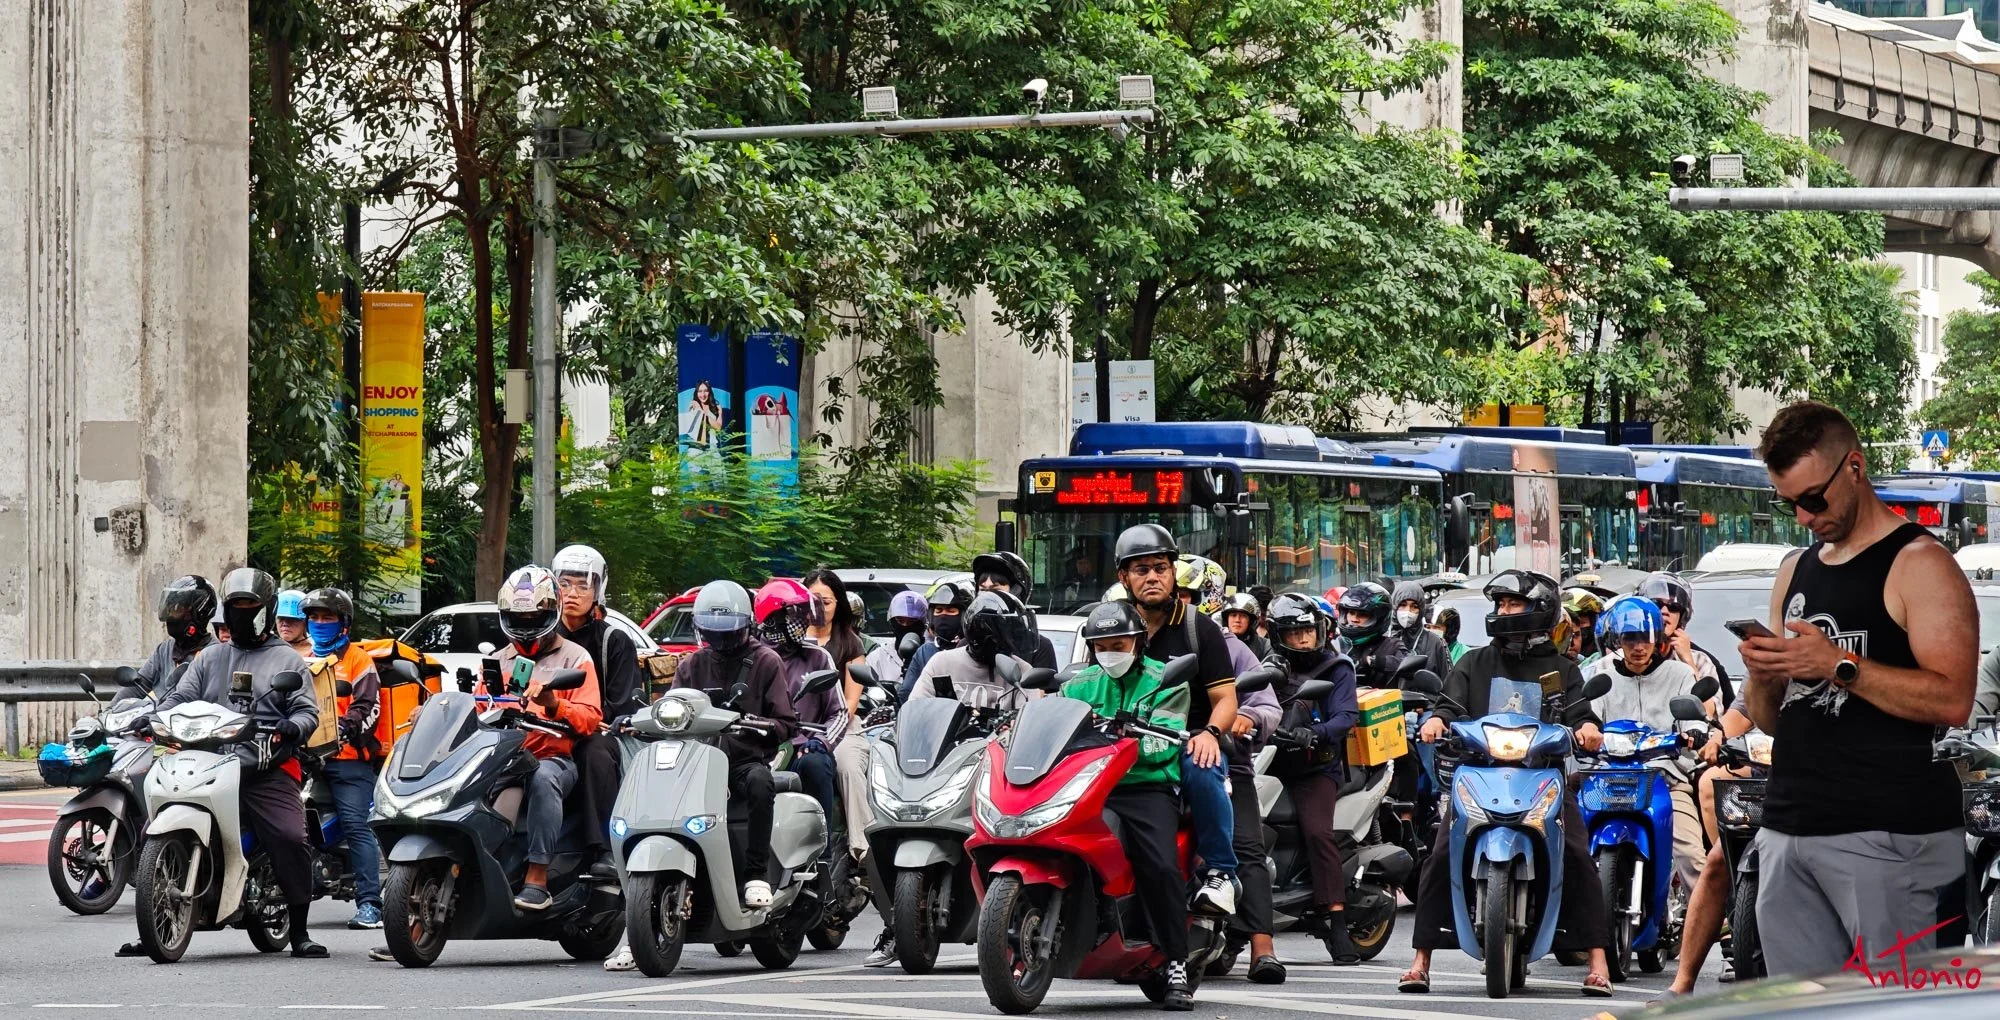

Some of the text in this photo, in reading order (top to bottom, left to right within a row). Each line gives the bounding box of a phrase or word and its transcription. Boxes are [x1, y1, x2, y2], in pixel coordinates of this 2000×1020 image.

[364, 386, 419, 399] ENJOY
[364, 408, 419, 417] SHOPPING
[1157, 482, 1181, 503] 77
